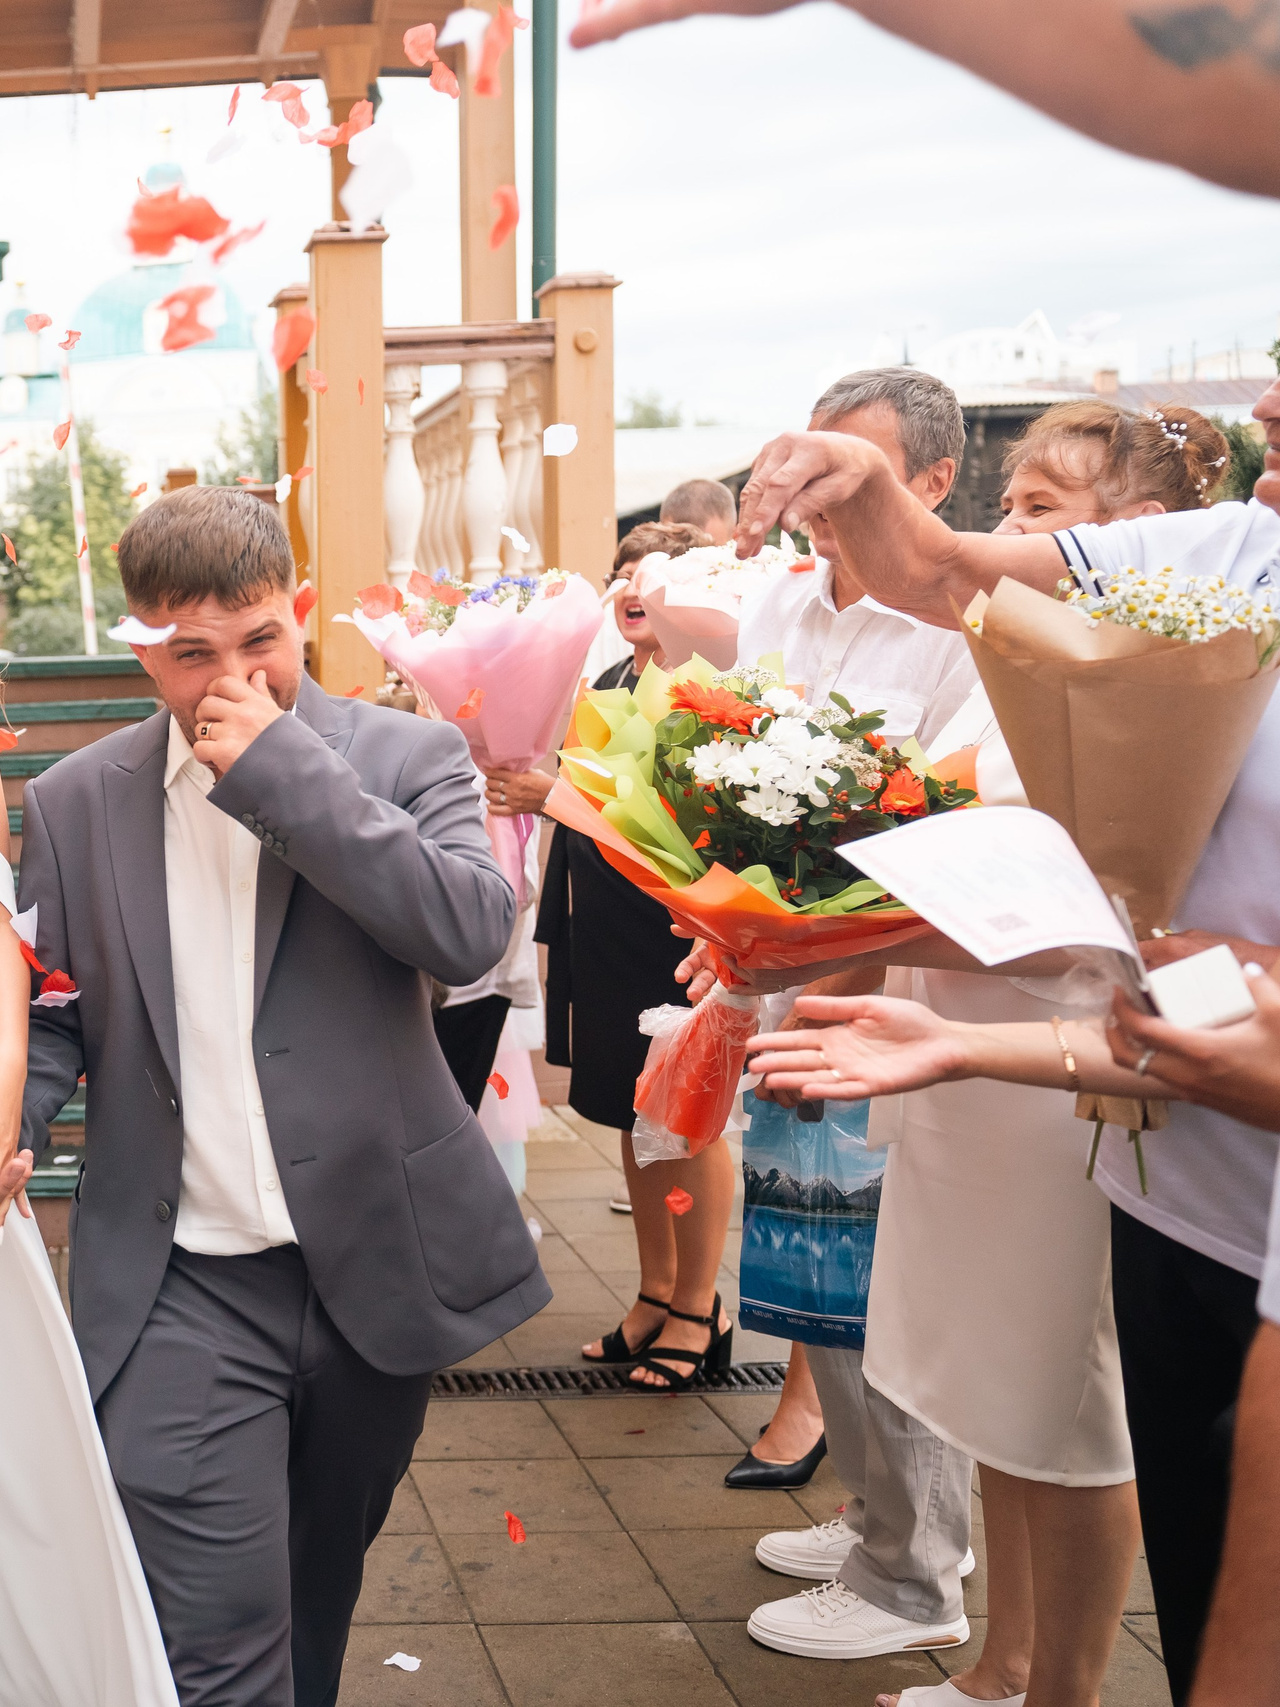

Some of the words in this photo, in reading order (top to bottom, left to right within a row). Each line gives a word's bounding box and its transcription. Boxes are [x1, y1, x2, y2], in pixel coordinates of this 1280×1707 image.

[752, 1309, 774, 1320] NATURE
[786, 1317, 810, 1327] NATURE
[821, 1322, 846, 1332] NATURE
